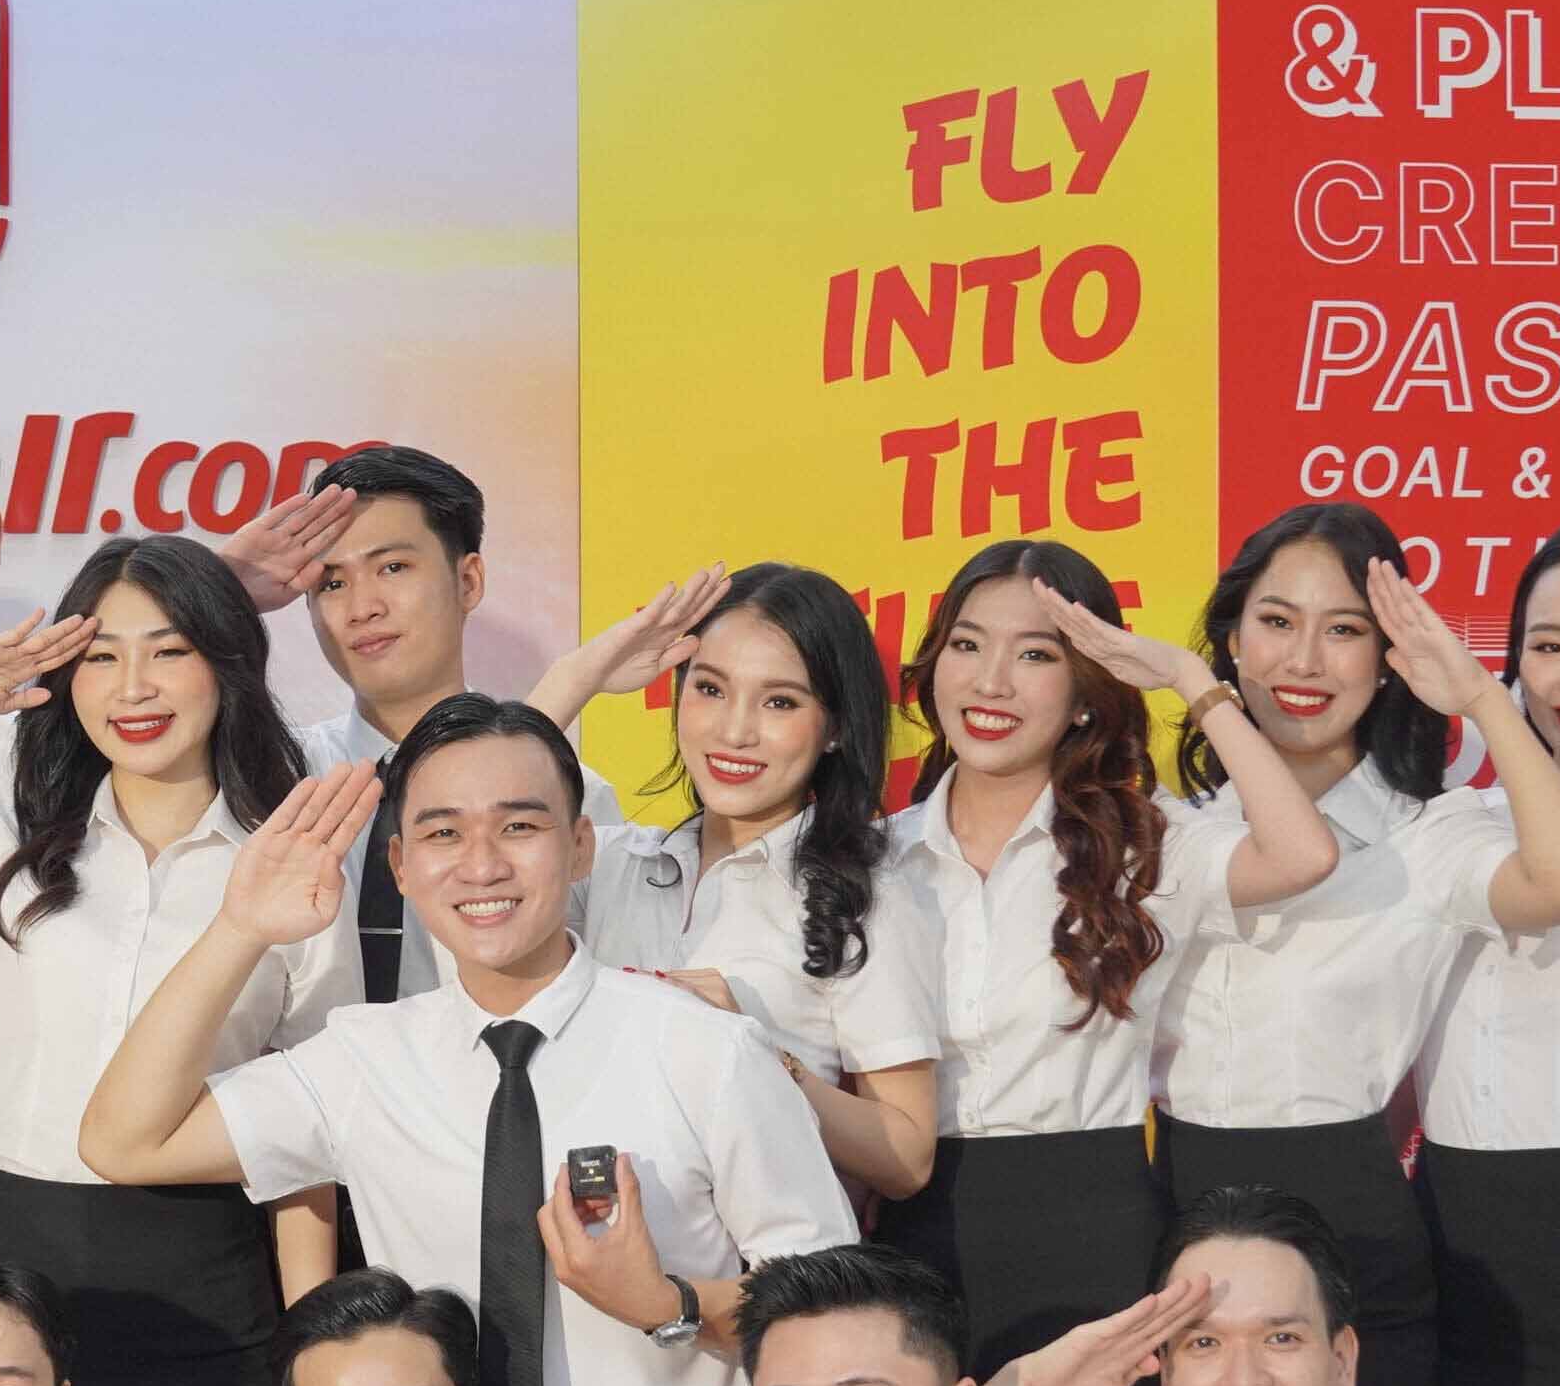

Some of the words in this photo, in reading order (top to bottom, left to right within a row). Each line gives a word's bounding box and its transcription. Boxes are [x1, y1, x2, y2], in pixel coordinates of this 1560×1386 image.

[1285, 3, 1383, 118] &
[903, 70, 1149, 212] FLY
[823, 244, 1141, 384] INTO
[881, 411, 1144, 541] THE
[1300, 446, 1485, 499] GOAL
[1512, 447, 1552, 499] &
